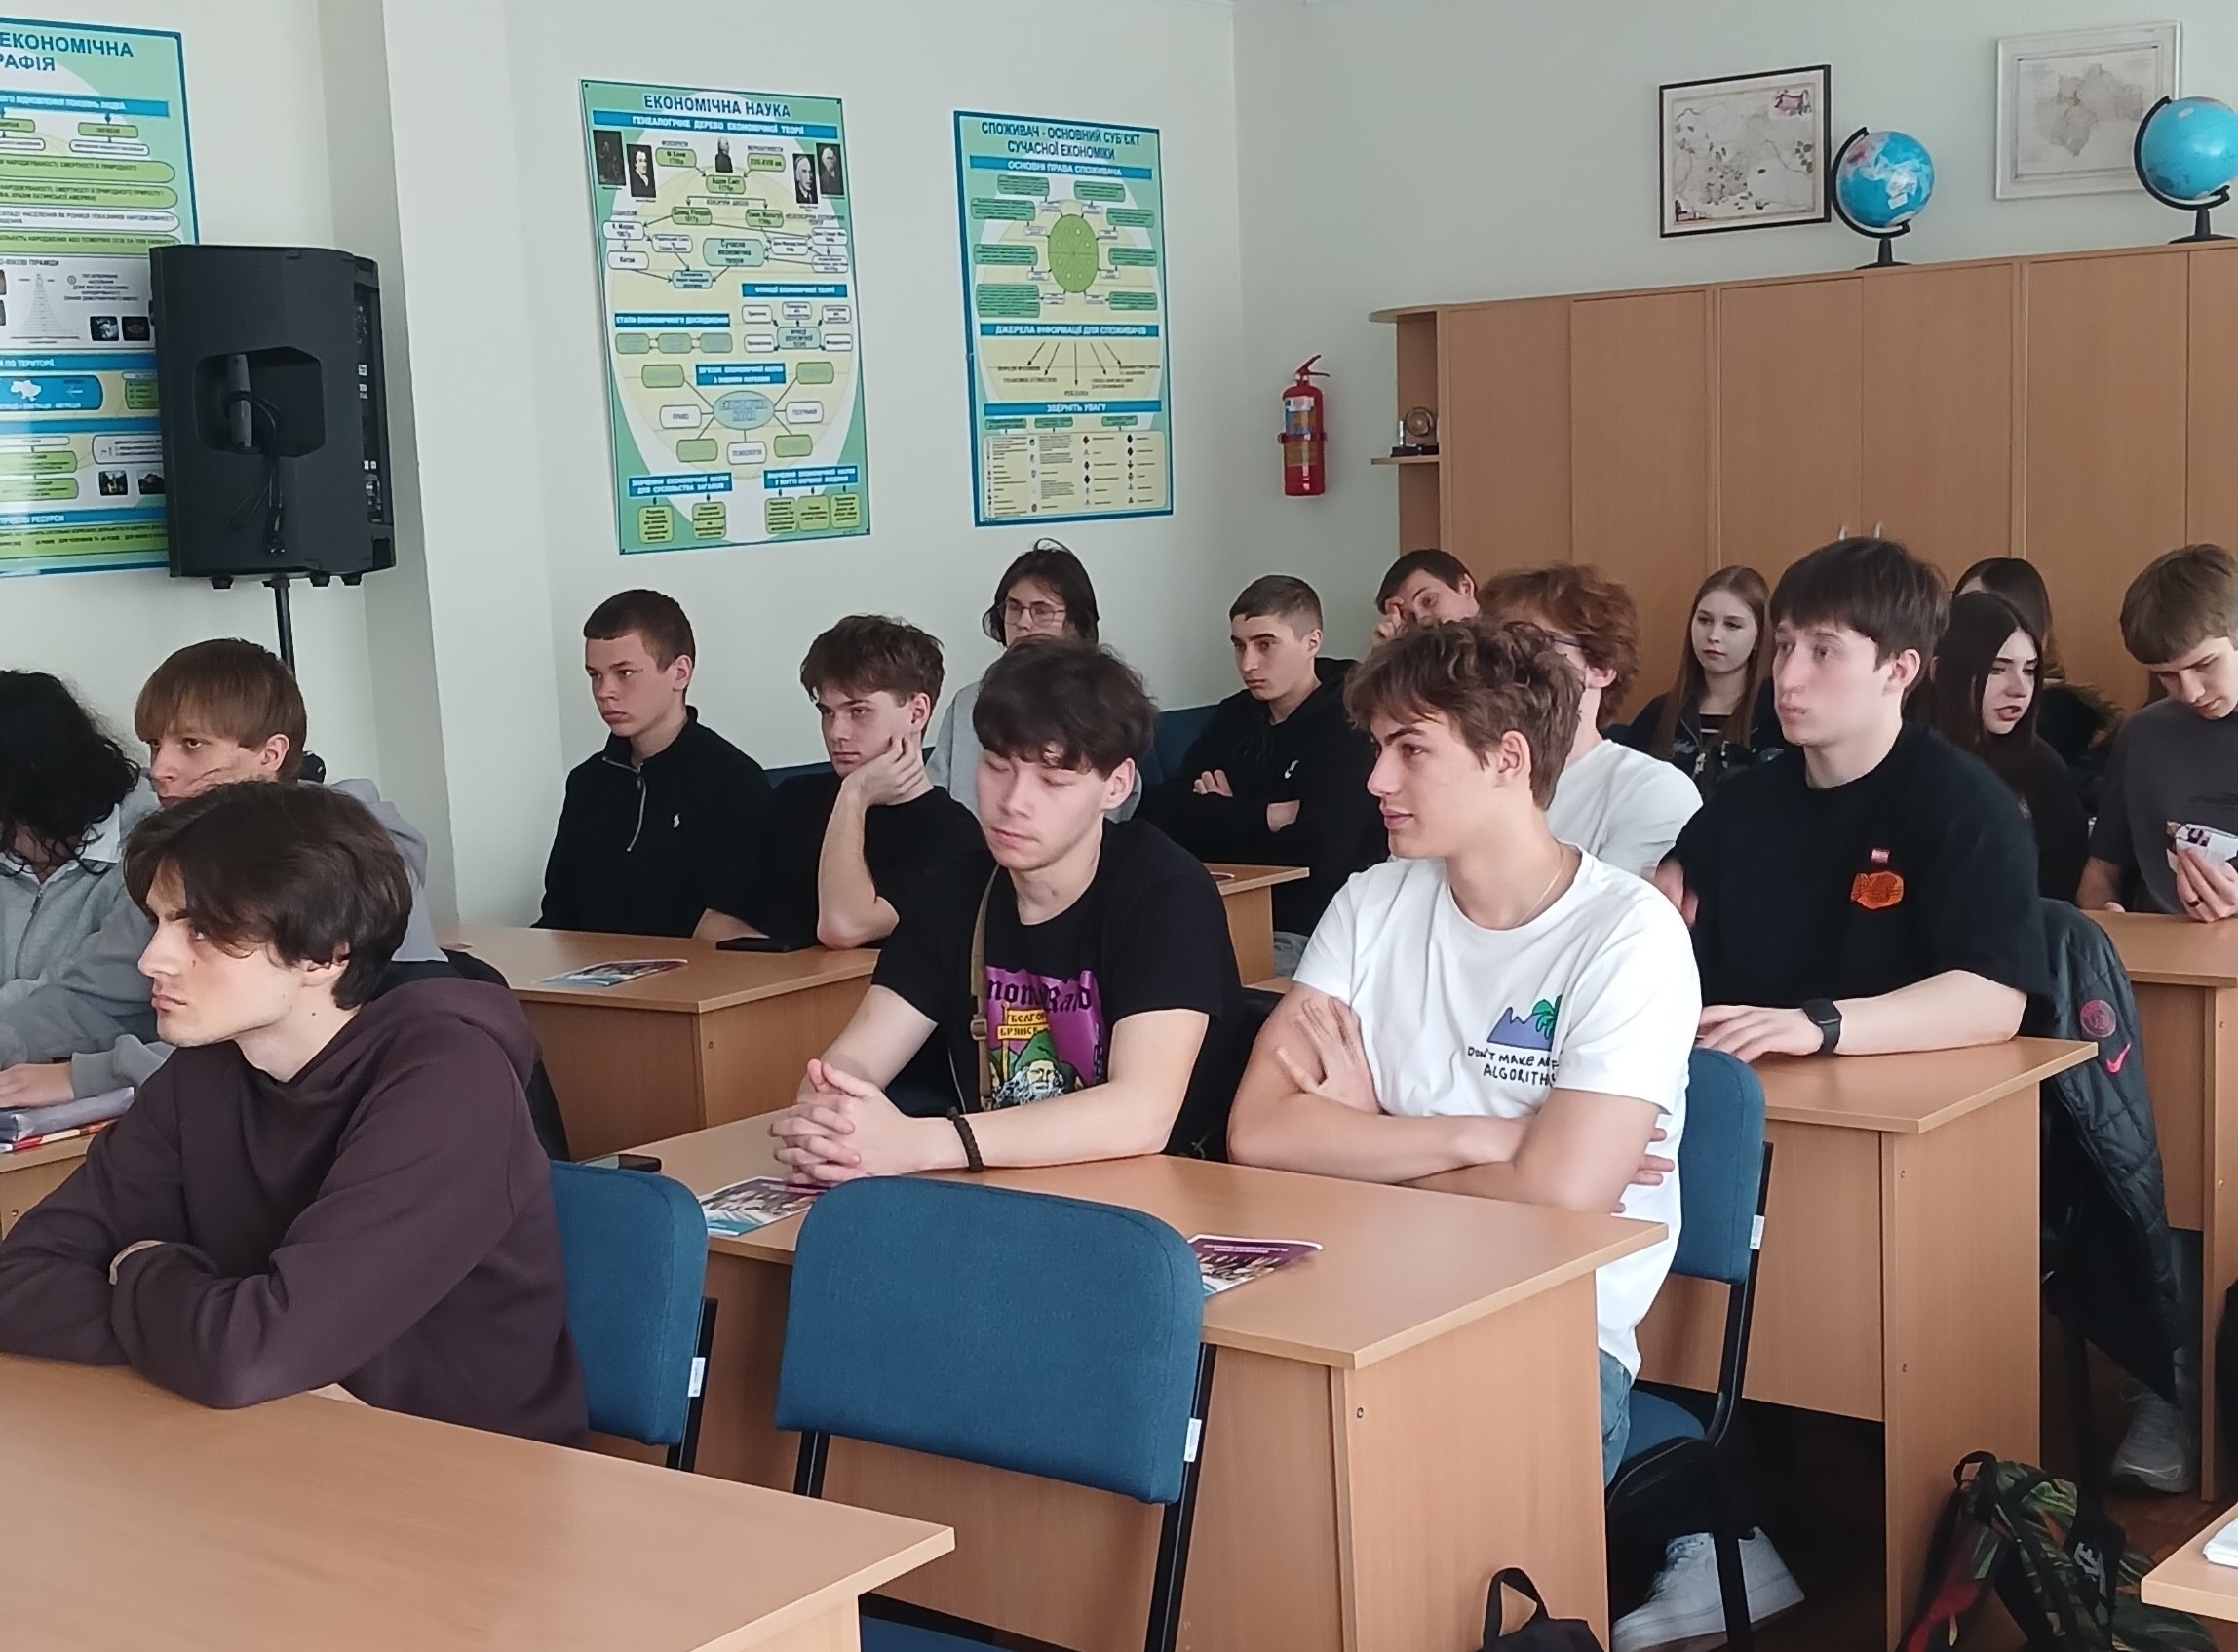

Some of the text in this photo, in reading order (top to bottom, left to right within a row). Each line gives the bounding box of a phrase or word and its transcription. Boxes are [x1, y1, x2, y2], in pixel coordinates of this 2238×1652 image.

[0, 32, 134, 58] ЕКОНОМІЧНА
[644, 95, 791, 118] ЕКОНОМІЧНА НАУКА
[982, 121, 1039, 137] СПОЖИВАЧ
[1047, 127, 1101, 143] ОСНОВНИЙ
[1008, 140, 1115, 160] СУЧАСНОЇ ЕКОНОМІКИ
[1467, 1046, 1496, 1060] DON'T
[1499, 1054, 1534, 1066] MAKE
